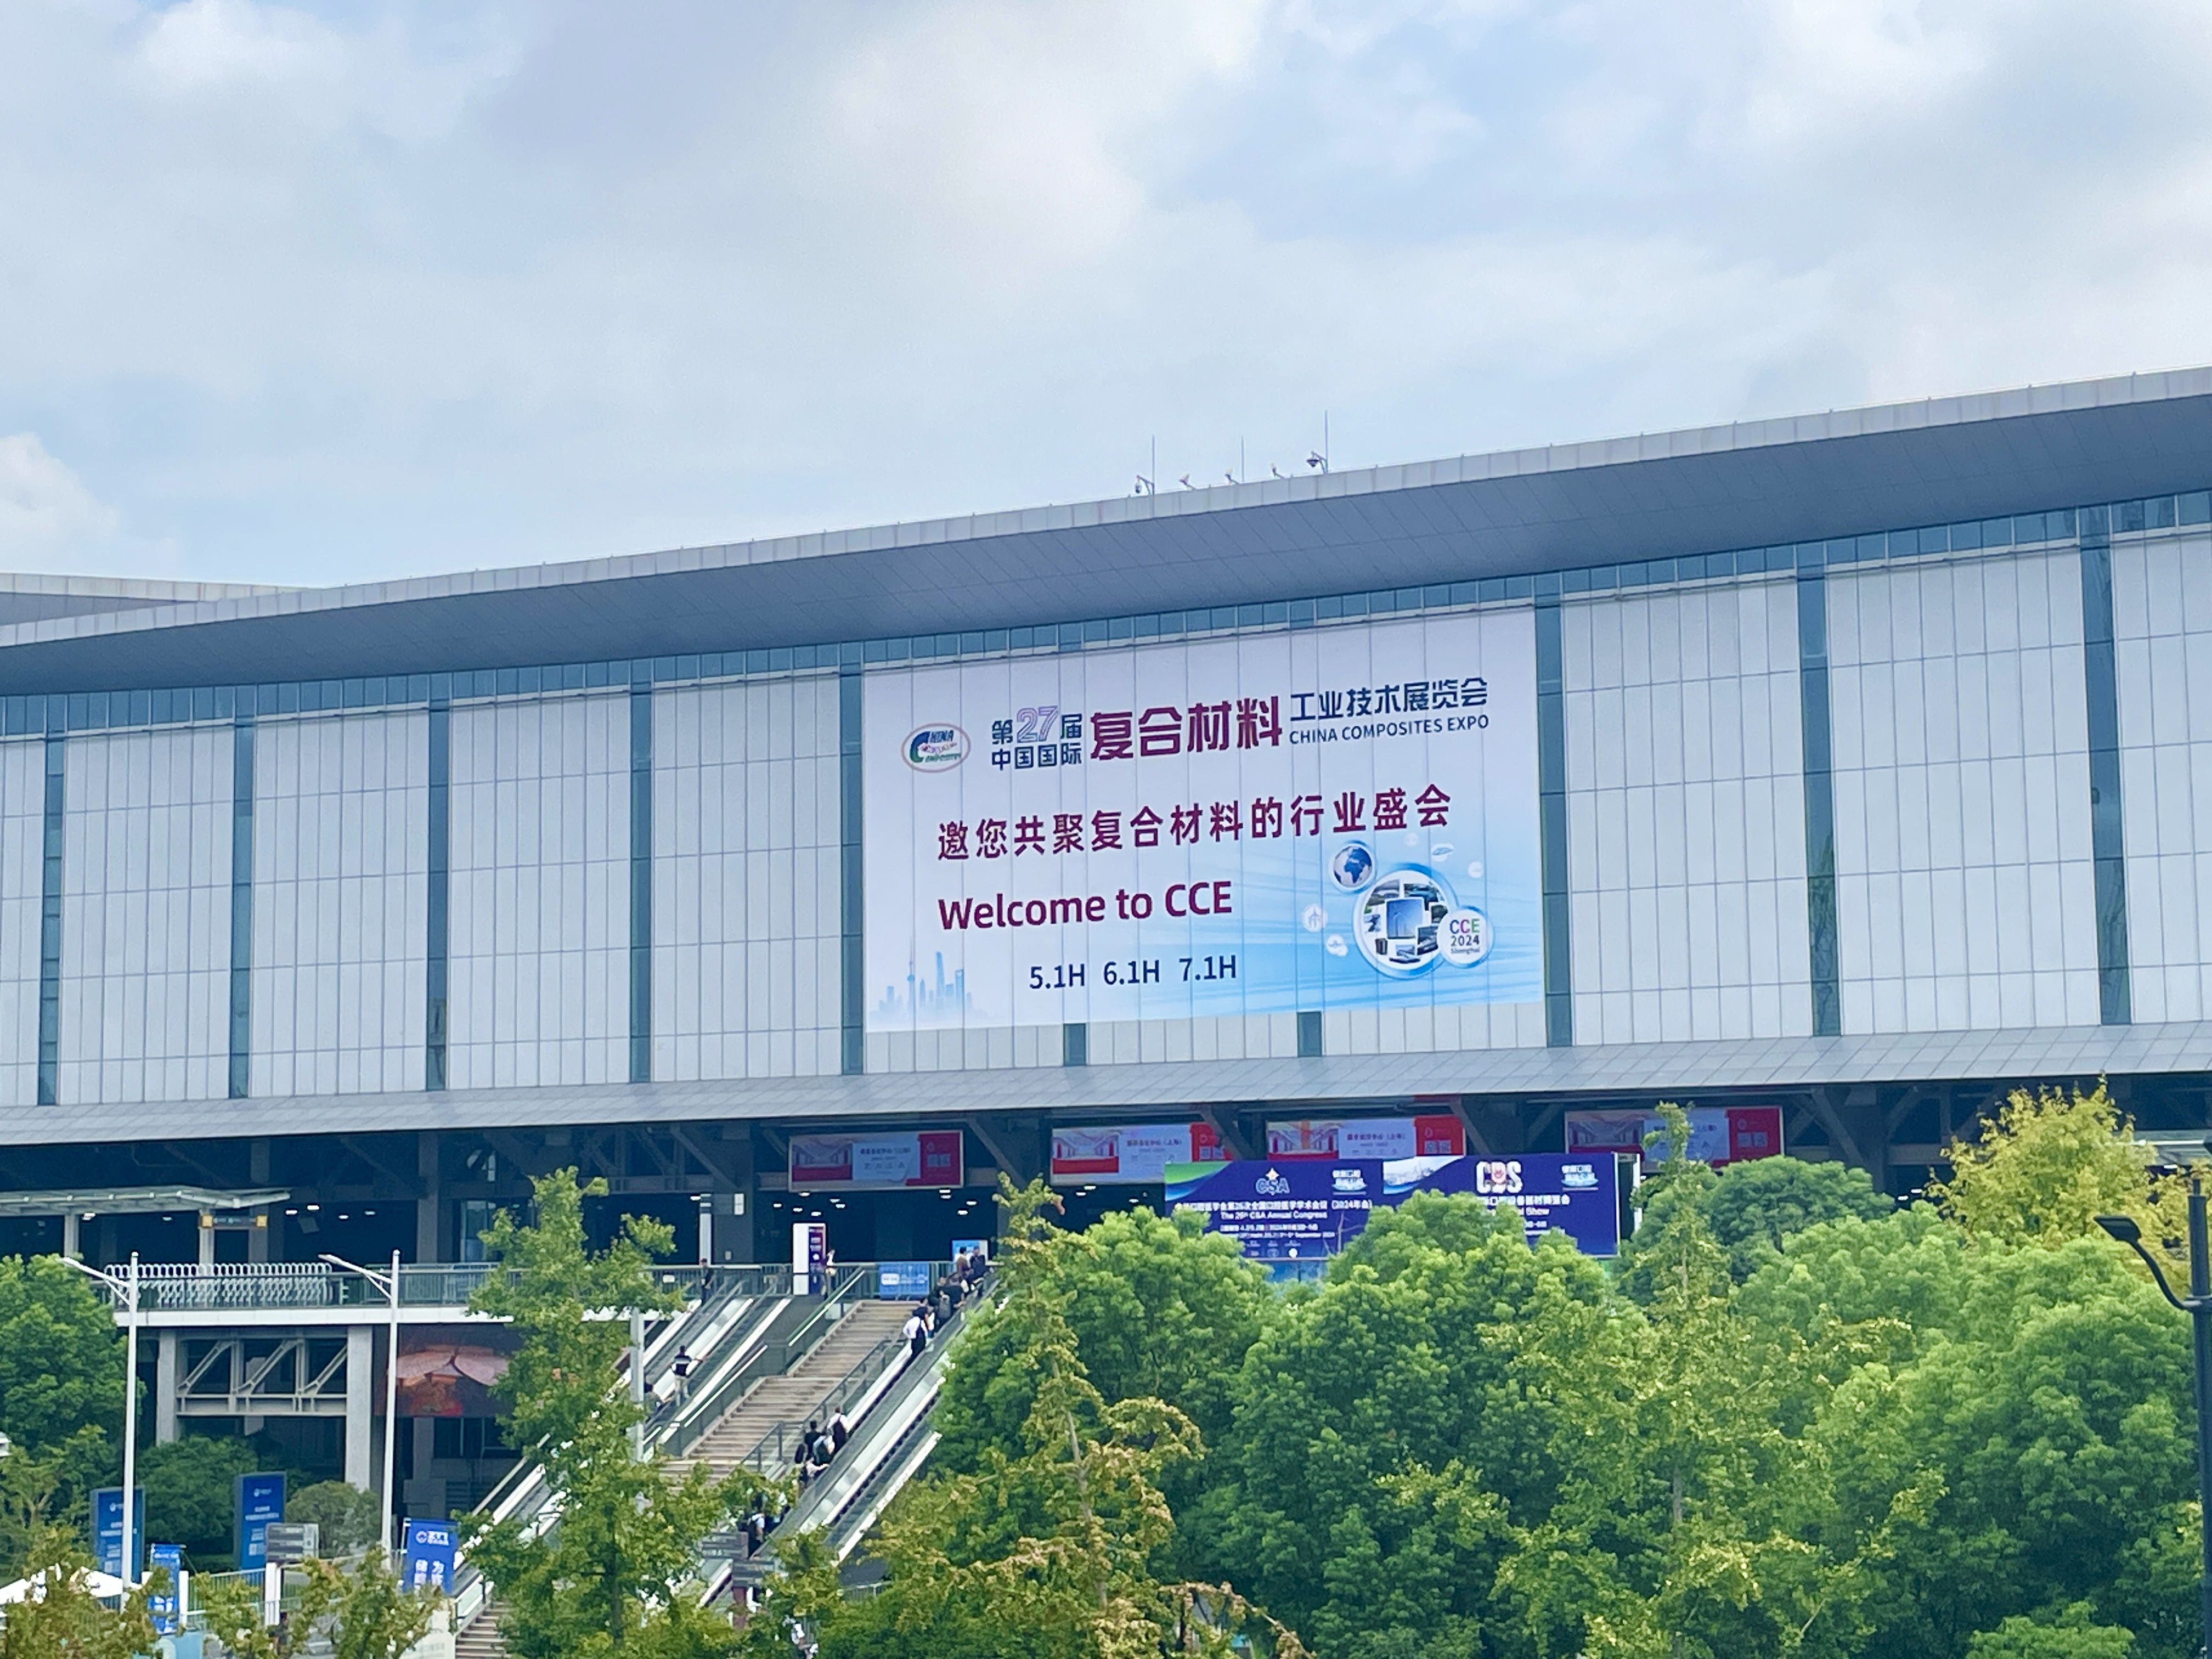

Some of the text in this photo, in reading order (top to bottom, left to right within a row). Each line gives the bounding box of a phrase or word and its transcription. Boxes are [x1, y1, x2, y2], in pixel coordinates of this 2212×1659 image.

[1290, 677, 1488, 721] 工业技术展览会
[991, 706, 1083, 744] 第27届
[1090, 695, 1283, 760] 复合材料
[1289, 714, 1489, 744] CHINA COMPOSITES EXPO
[991, 743, 1082, 771] 中国国际
[938, 784, 1451, 861] 邀您共聚复合材料的行业盛会
[939, 880, 1233, 930] Welcome to CCE
[1449, 918, 1480, 934] CCE
[1451, 935, 1480, 946] 2024
[1030, 955, 1237, 989] 5.1H 6.1H 7.1H
[1256, 1178, 1290, 1195] CSA
